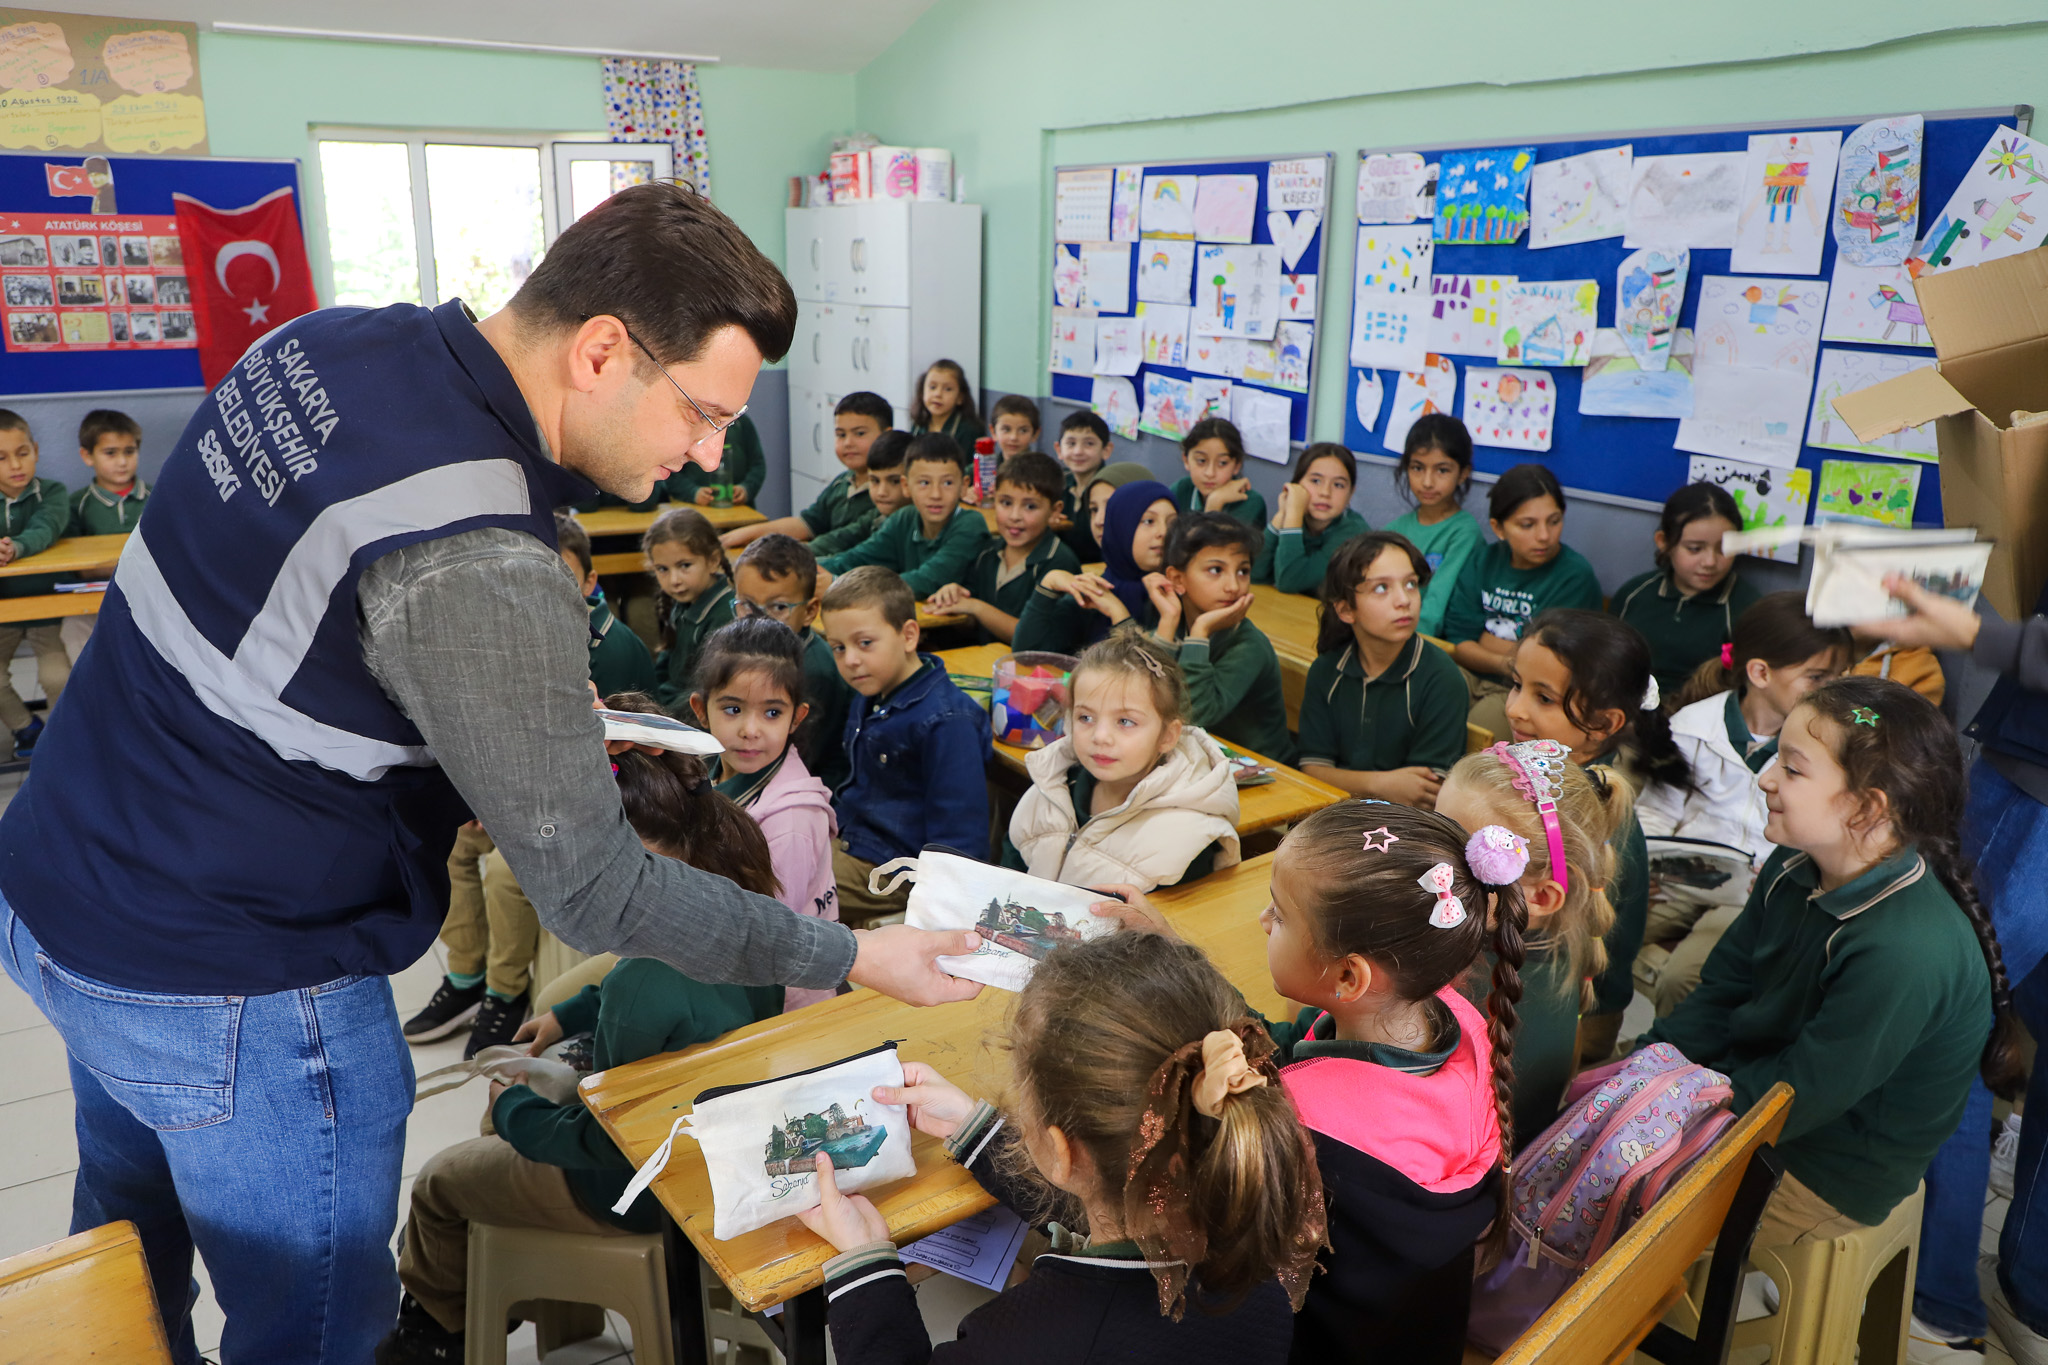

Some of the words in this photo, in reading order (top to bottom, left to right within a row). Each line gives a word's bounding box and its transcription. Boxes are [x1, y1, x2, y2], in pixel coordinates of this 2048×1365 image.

[80, 69, 109, 85] 1/A
[56, 96, 79, 104] 1922
[45, 220, 98, 231] ATATÜRK
[100, 220, 143, 232] KÖŞESİ
[276, 338, 340, 446] SAKARYA
[243, 348, 319, 482] BÜYÜKŞEHİR
[215, 376, 287, 508] BELEDİYESİ
[1481, 589, 1532, 616] WORLD
[770, 1175, 810, 1198] Sakarya
